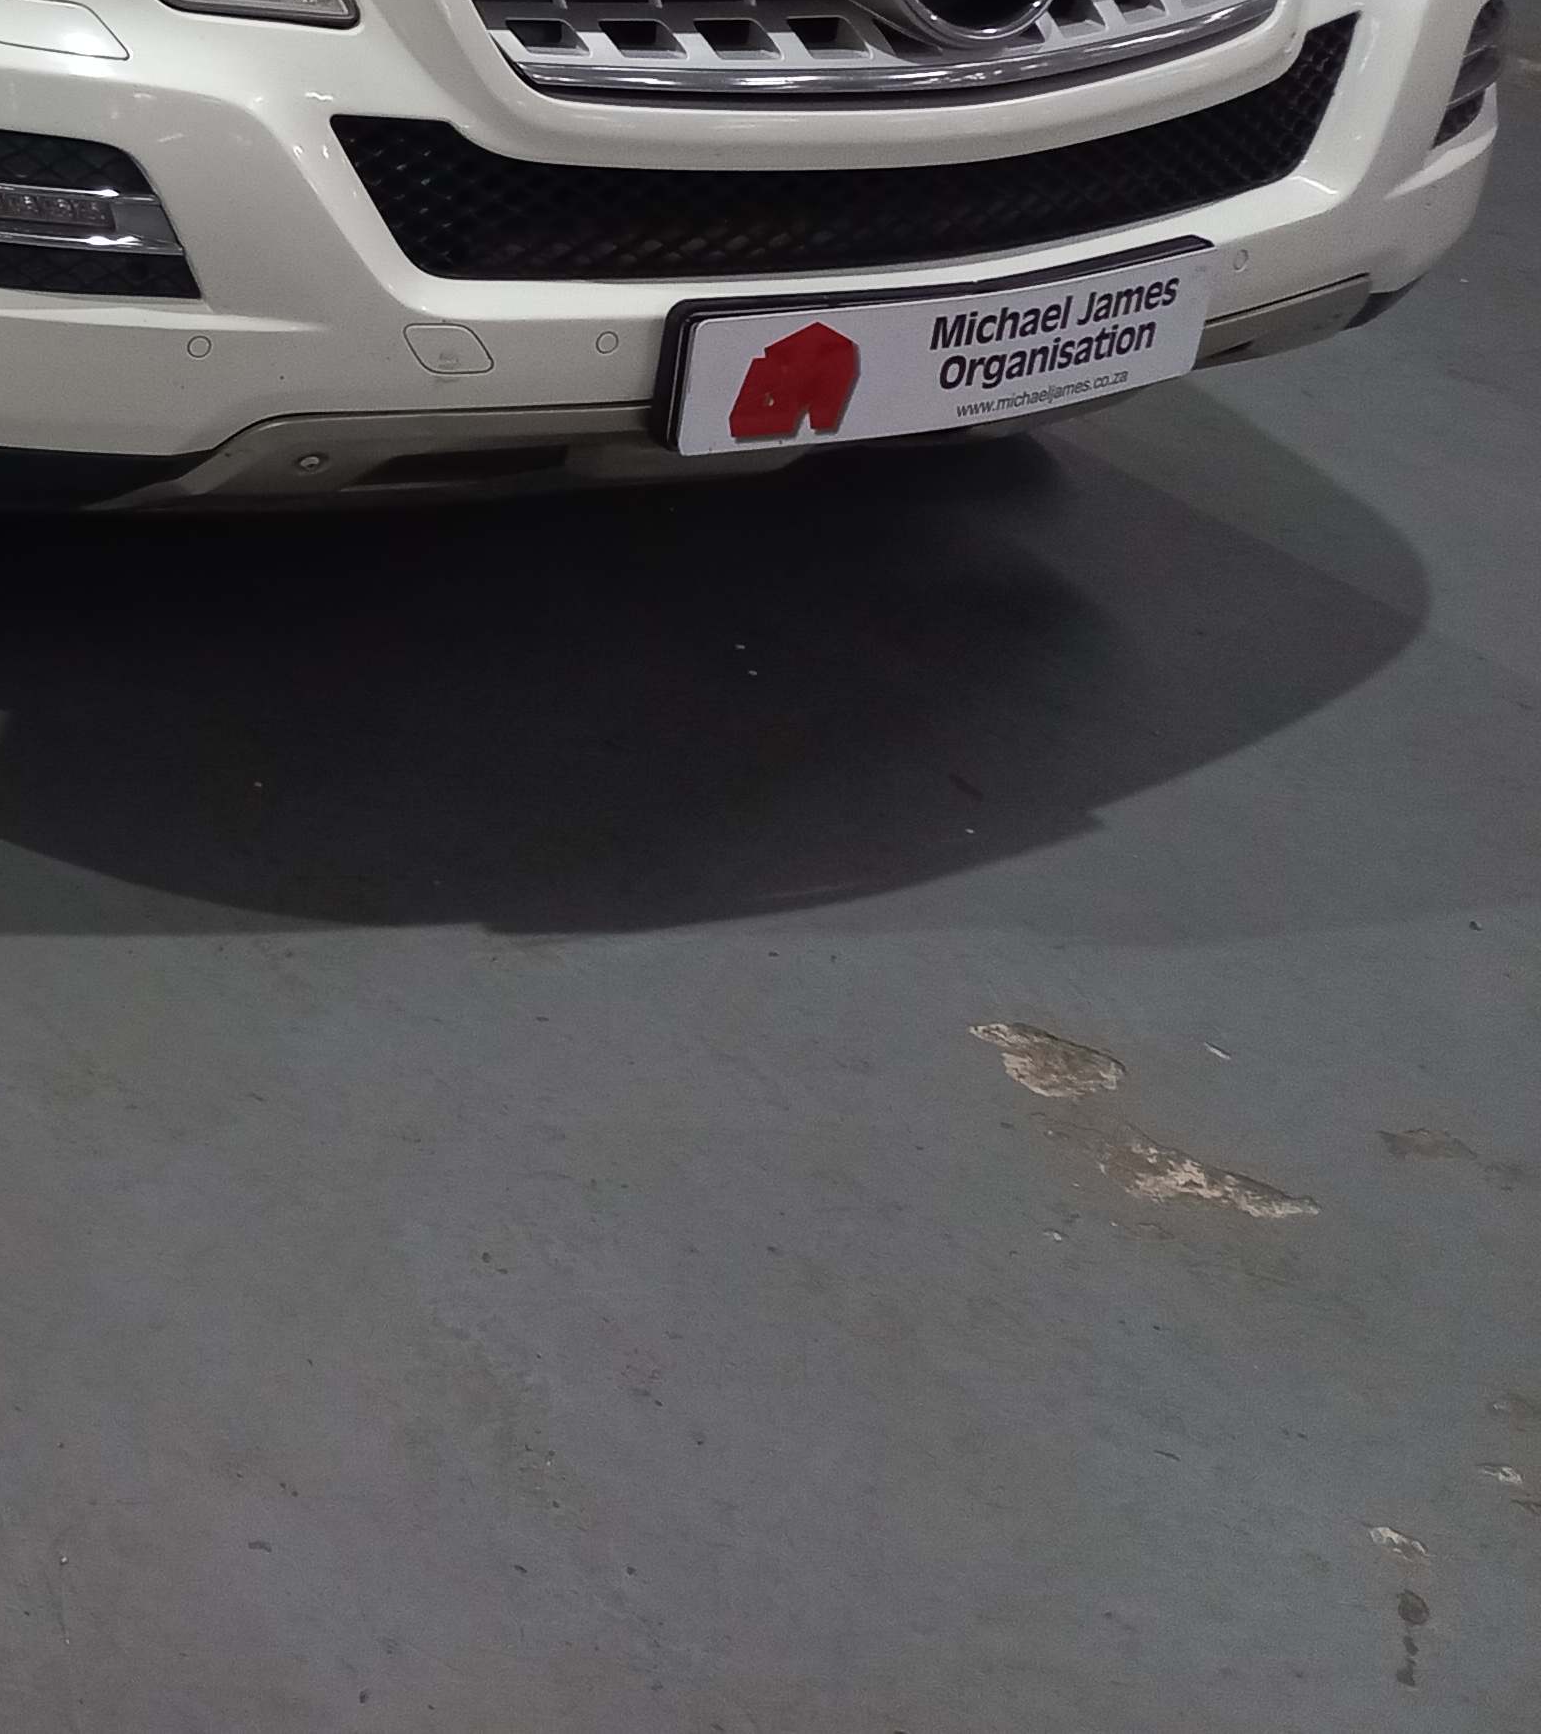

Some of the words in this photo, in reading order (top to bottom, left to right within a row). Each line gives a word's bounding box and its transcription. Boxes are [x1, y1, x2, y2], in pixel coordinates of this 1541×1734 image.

[929, 294, 1072, 351] Michael
[1076, 276, 1180, 326] James
[939, 321, 1157, 390] Organisation
[956, 370, 1129, 418] www.michaeljames.co.za
